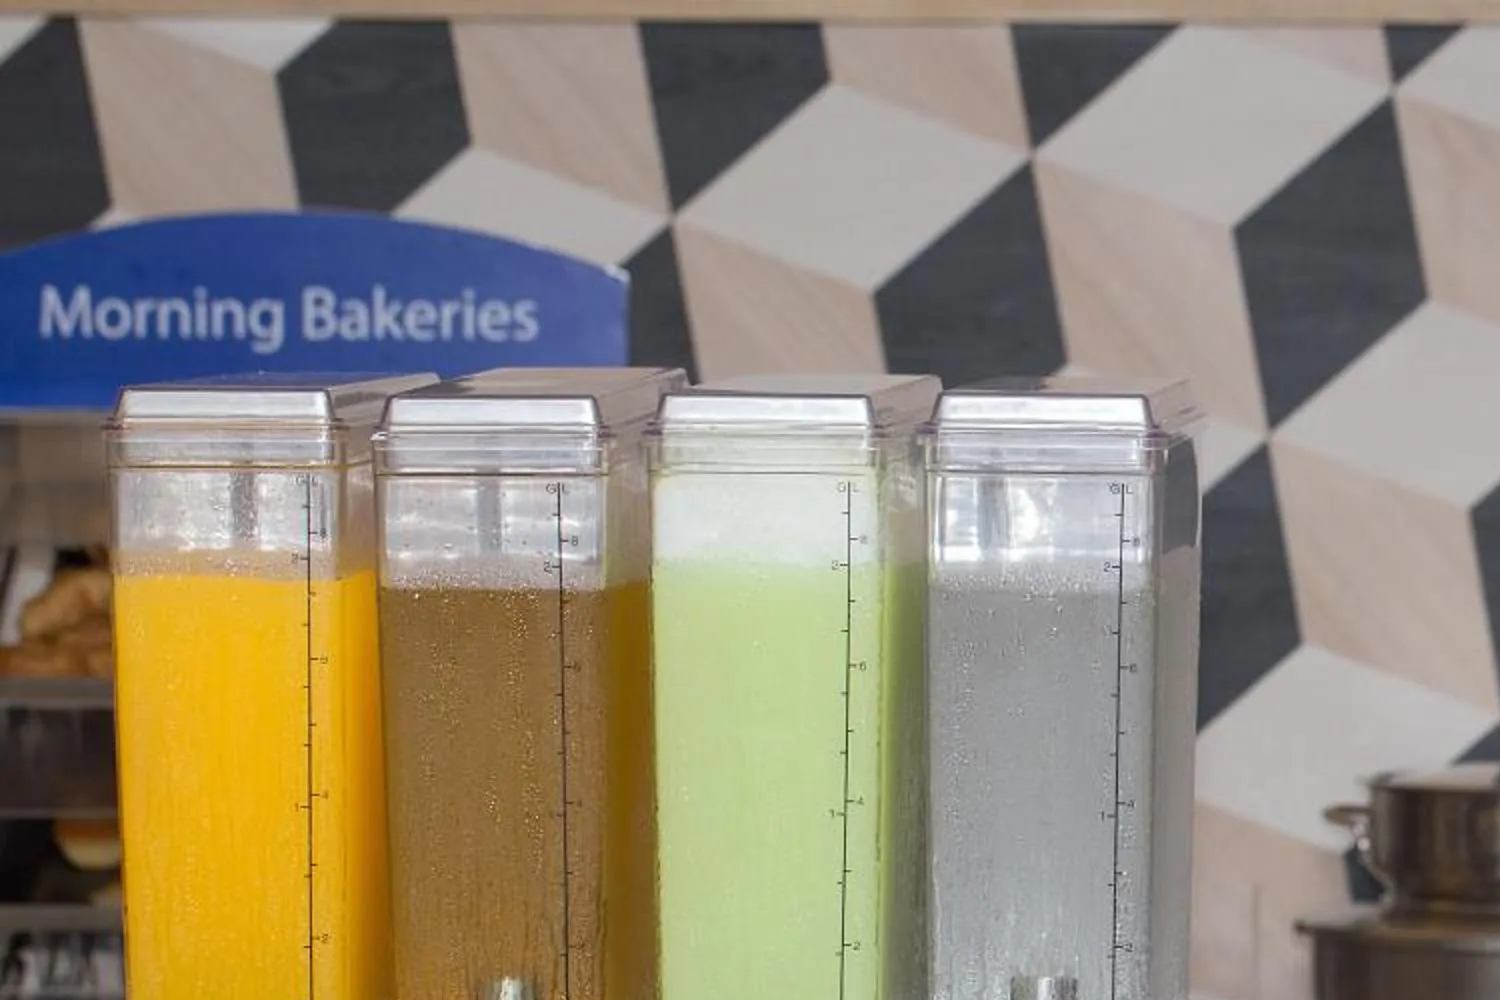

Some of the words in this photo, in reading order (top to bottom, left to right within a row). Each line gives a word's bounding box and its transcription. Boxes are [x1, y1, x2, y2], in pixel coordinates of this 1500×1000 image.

[39, 285, 285, 353] Morning
[303, 287, 540, 342] Bakeries
[545, 484, 557, 494] G
[1110, 484, 1121, 494] G
[1126, 484, 1133, 494] L
[571, 535, 579, 546] 8
[544, 561, 552, 574] 2
[1103, 562, 1111, 573] 2
